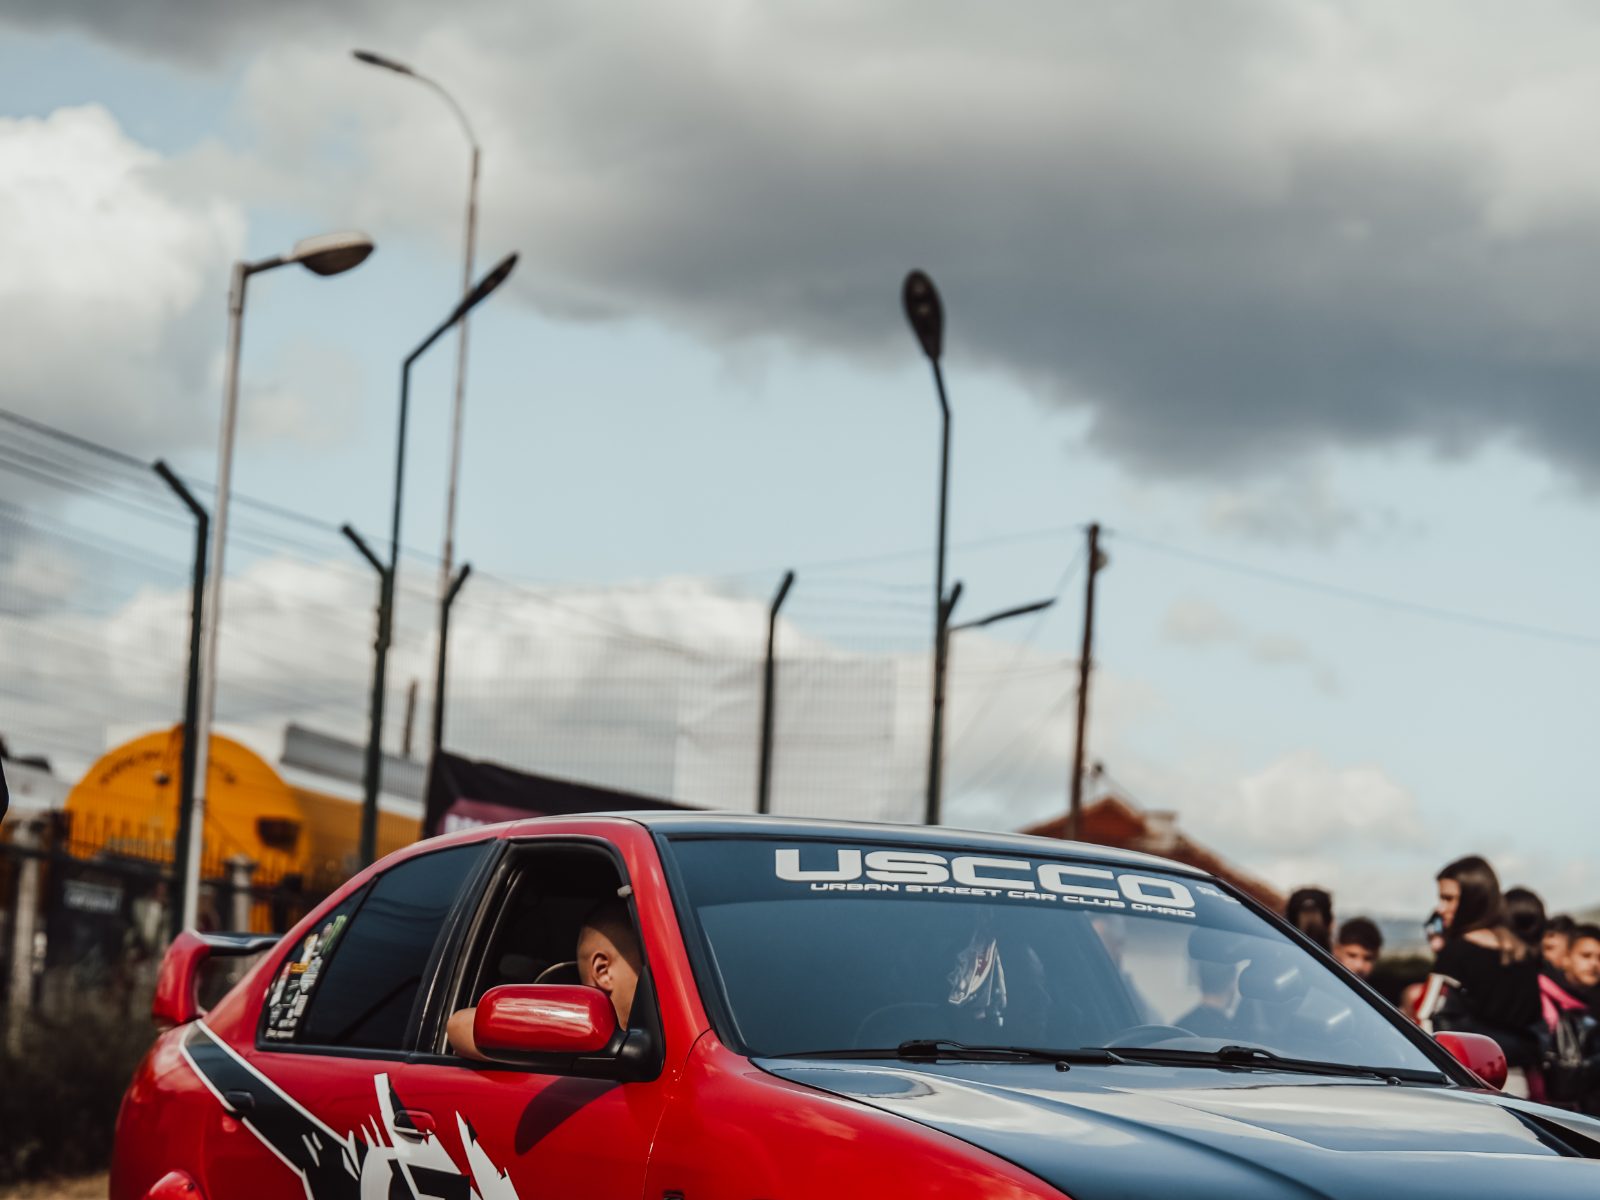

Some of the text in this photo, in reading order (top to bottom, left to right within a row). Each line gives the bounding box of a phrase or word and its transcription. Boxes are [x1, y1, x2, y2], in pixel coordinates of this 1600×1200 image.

[775, 848, 1196, 909] USCCO
[811, 883, 1196, 918] URBAN STREET CAR CLUB OHRID
